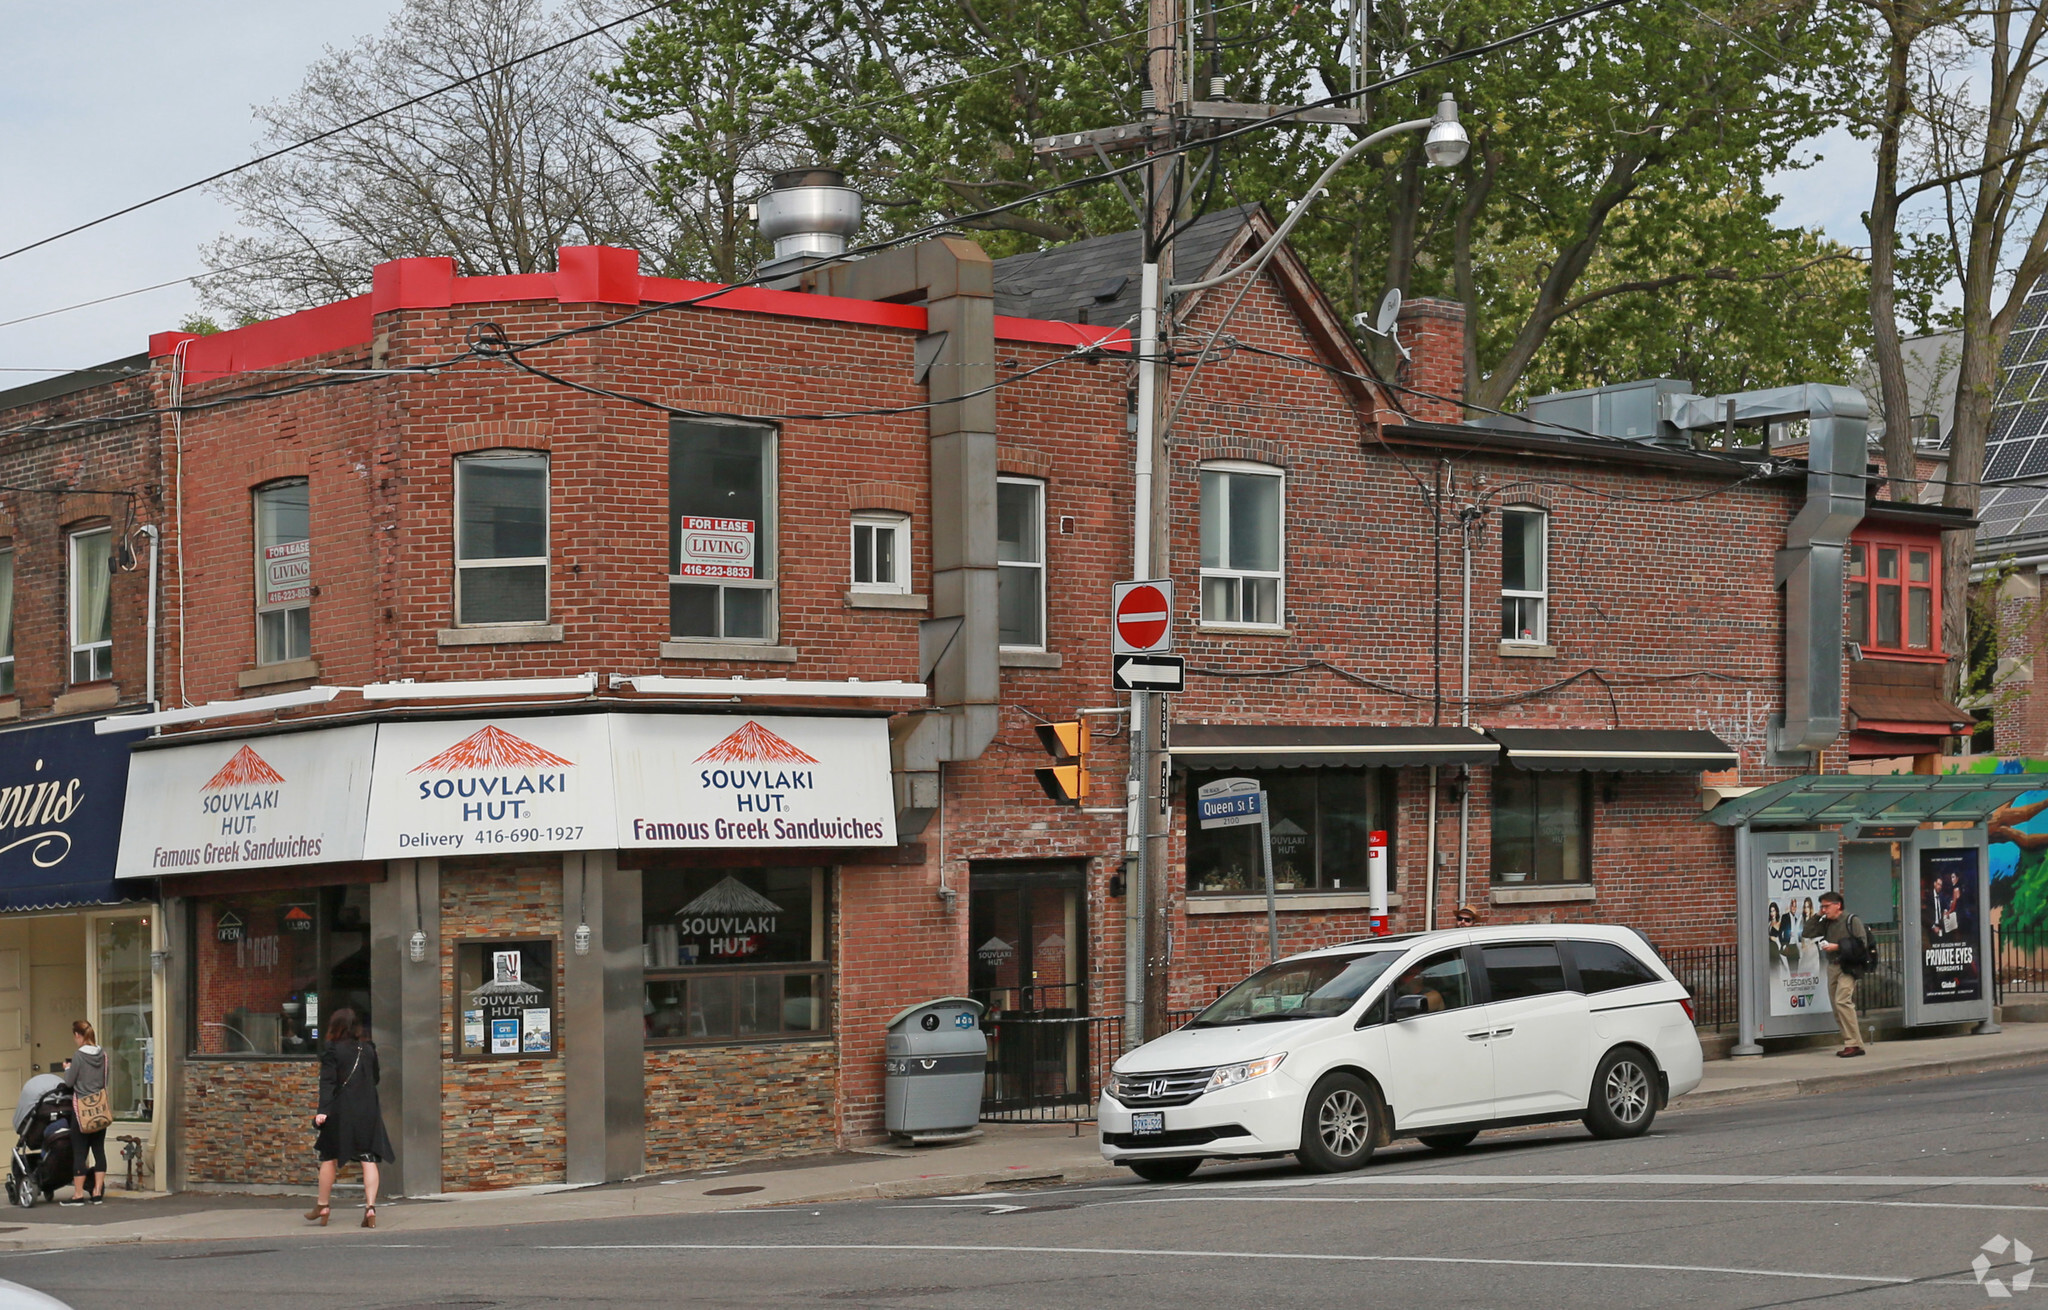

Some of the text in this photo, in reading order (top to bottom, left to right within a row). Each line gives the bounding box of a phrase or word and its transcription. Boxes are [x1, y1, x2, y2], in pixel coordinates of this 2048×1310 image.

[689, 518, 749, 532] FOR LEASE
[269, 542, 310, 557] FOR LEASE
[692, 538, 744, 554] LIVING
[273, 562, 308, 580] LIVING
[419, 773, 566, 800] SOUVLAKI
[700, 769, 814, 790] SOUVLAKI
[203, 790, 279, 814] SOUVLAKI
[737, 794, 785, 813] HUT
[1204, 796, 1255, 817] Queen St E
[463, 800, 526, 822] HUT
[221, 815, 255, 836] HUT
[633, 817, 884, 840] Famous Greek Sandwiches
[1223, 816, 1240, 826] 2100
[399, 826, 585, 849] Delivery 416-690-1927
[1271, 836, 1306, 845] OUVLAKI
[153, 834, 323, 868] Famous Greek Sandwiches
[1278, 846, 1295, 854] HUT
[1768, 865, 1828, 879] WORLD OF
[1782, 878, 1826, 891] DANCE
[218, 927, 240, 940] OPEN
[682, 916, 776, 935] SOUVLAKI
[710, 936, 751, 955] HUT
[978, 951, 1012, 960] SOUVLAKI
[988, 958, 1004, 966] HUT
[1925, 946, 1973, 966] PRIVATE EYES
[1783, 976, 1819, 987] TUESDAYS 10
[472, 994, 539, 1007] SOUVLAKI
[1790, 993, 1814, 1008] CTV
[491, 1006, 521, 1017] HUT
